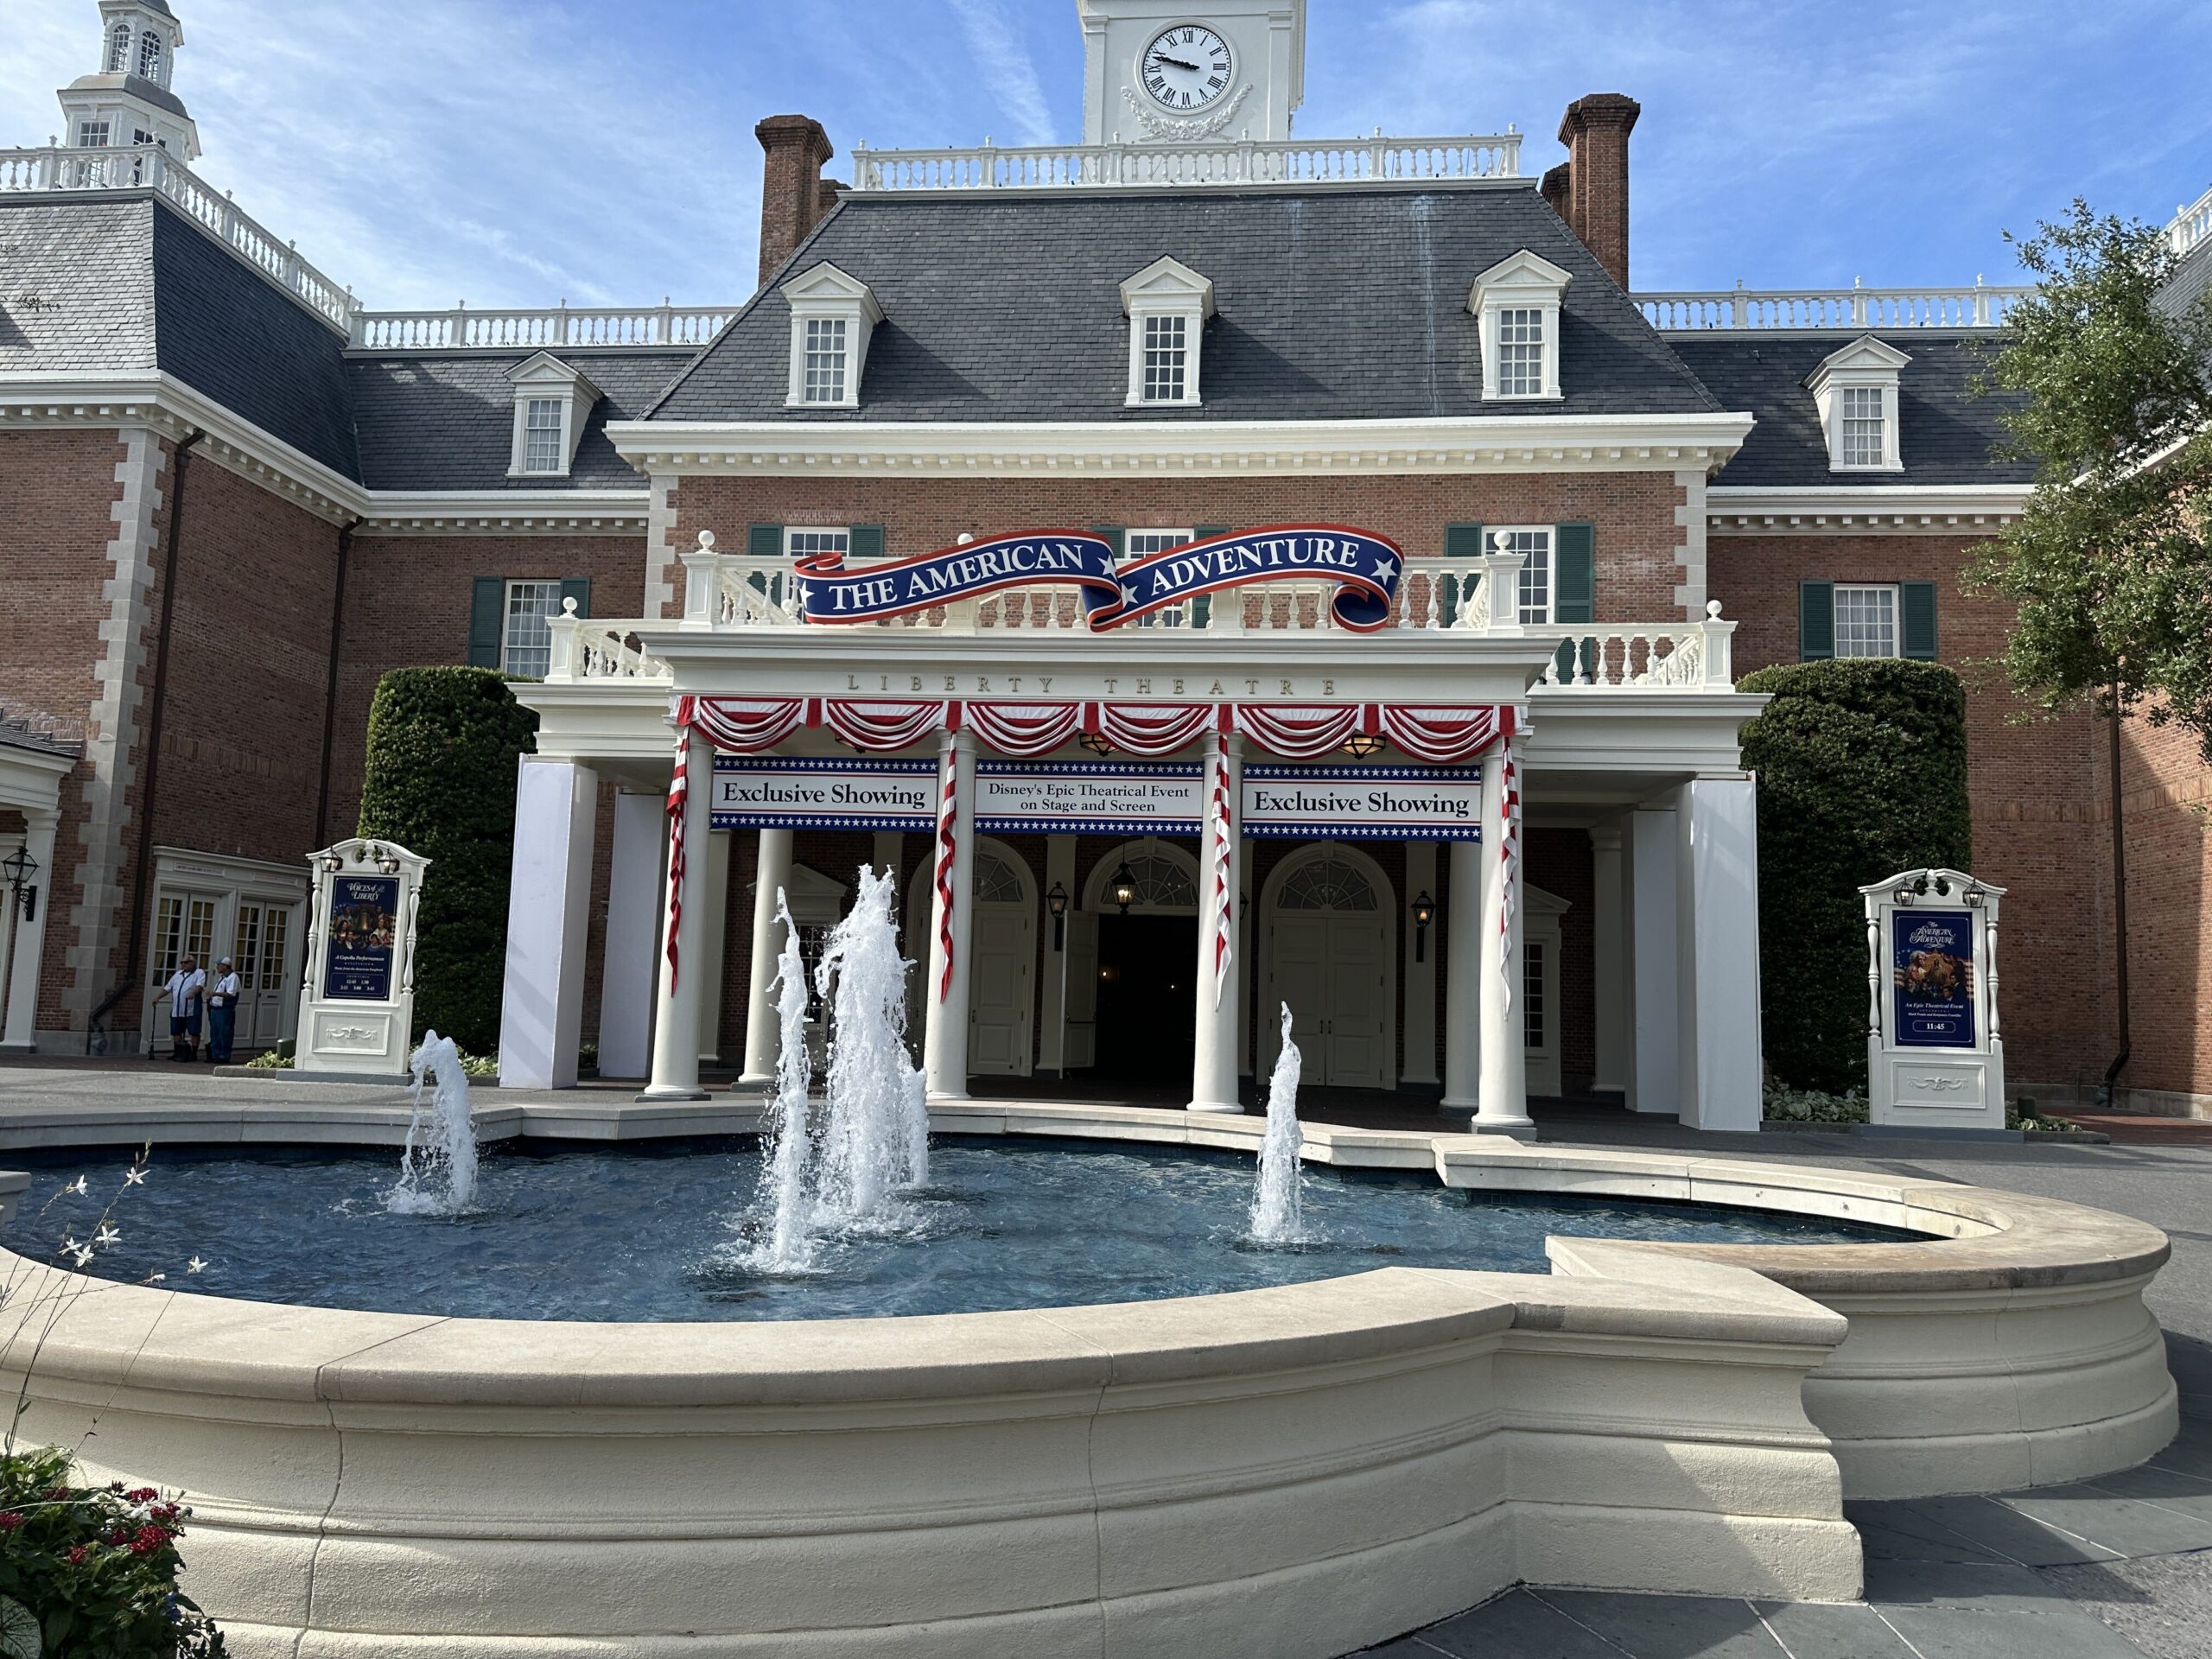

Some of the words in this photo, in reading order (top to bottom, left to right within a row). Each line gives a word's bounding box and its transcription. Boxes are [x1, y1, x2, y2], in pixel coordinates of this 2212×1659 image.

[1165, 35, 1179, 48] XI
[1182, 31, 1193, 43] XII
[1210, 47, 1223, 56] II
[1147, 64, 1161, 73] IX
[1150, 75, 1166, 92] VIII
[1207, 75, 1224, 89] IIII
[1162, 87, 1176, 103] VII
[1182, 92, 1191, 105] VI
[1198, 88, 1208, 100] V
[829, 577, 898, 610] THE
[906, 543, 1084, 599] AMERICAN
[1151, 537, 1359, 596] ADVENTURE
[848, 675, 1052, 692] LIBERTY
[1104, 678, 1335, 695] THEATRE
[722, 782, 825, 803] Exclusive
[831, 784, 926, 810] Showing
[988, 783, 1042, 798] Disney's
[1046, 784, 1075, 798] Epic
[1078, 784, 1146, 798] Theatrical
[1151, 785, 1190, 798] Event
[1020, 801, 1037, 810] on
[1041, 799, 1077, 813] Stage
[1081, 799, 1105, 811] and
[1110, 800, 1155, 811] Screen
[1253, 791, 1362, 811] Exclusive
[1368, 791, 1470, 818] Showing
[351, 890, 380, 902] LIBERTY
